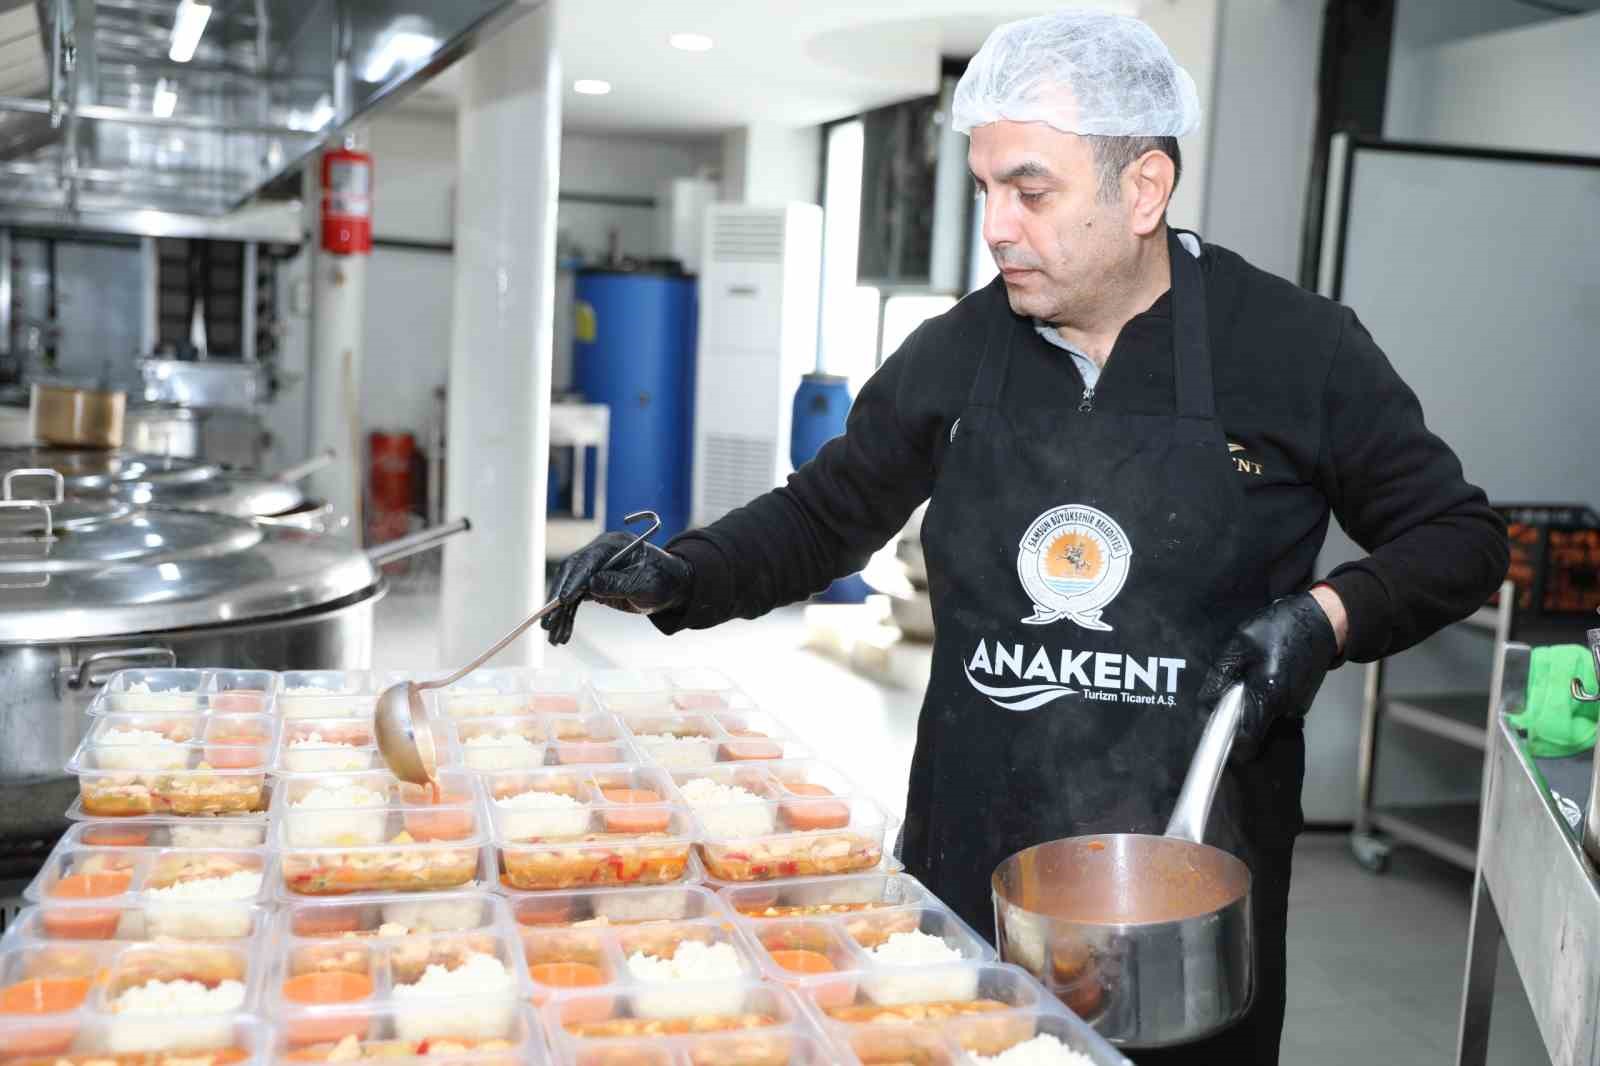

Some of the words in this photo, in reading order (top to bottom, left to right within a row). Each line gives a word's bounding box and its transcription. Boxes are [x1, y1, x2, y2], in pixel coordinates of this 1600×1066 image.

[1028, 520, 1052, 548] SAMSUN
[968, 637, 1187, 693] ANAKENT
[1083, 688, 1118, 702] Turizm
[1120, 691, 1155, 705] Ticaret
